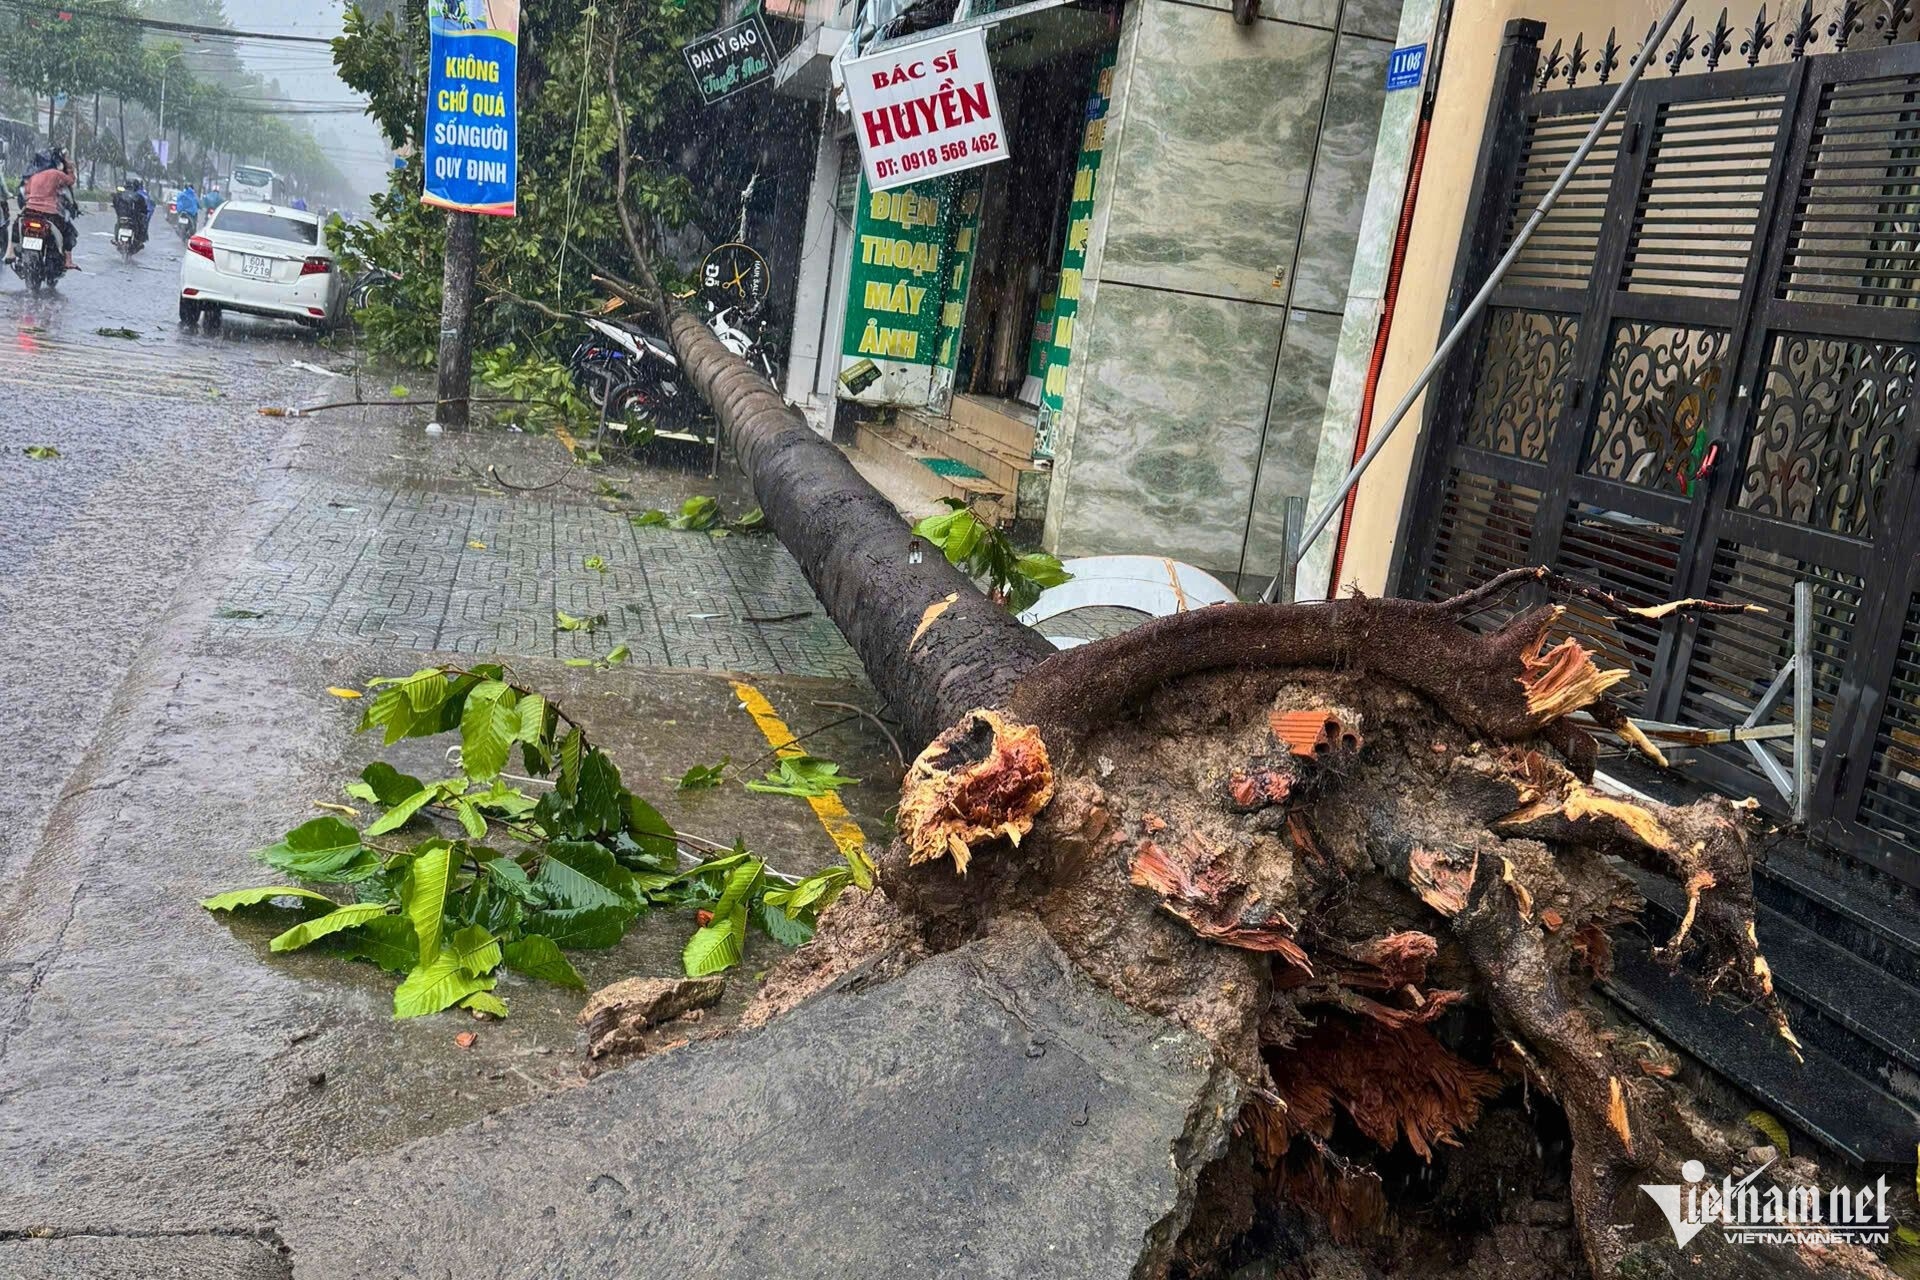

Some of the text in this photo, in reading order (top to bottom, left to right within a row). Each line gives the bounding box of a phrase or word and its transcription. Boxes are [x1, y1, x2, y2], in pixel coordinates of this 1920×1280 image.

[445, 54, 499, 83] KHÔNG
[691, 28, 758, 70] ĐẠI LÝ GẠO
[872, 49, 960, 90] BÁC SĨ
[1393, 52, 1422, 73] 1108
[437, 83, 506, 118] CHỞ QUÁ
[861, 78, 992, 148] HUYỀN
[435, 156, 507, 186] QUY ĐỊNH
[876, 132, 999, 179] ĐT: 0918 568 462
[870, 188, 939, 229] ĐIỆN
[860, 234, 940, 277] THOẠI
[864, 280, 926, 315] MÁY
[858, 318, 918, 359] ẢNH
